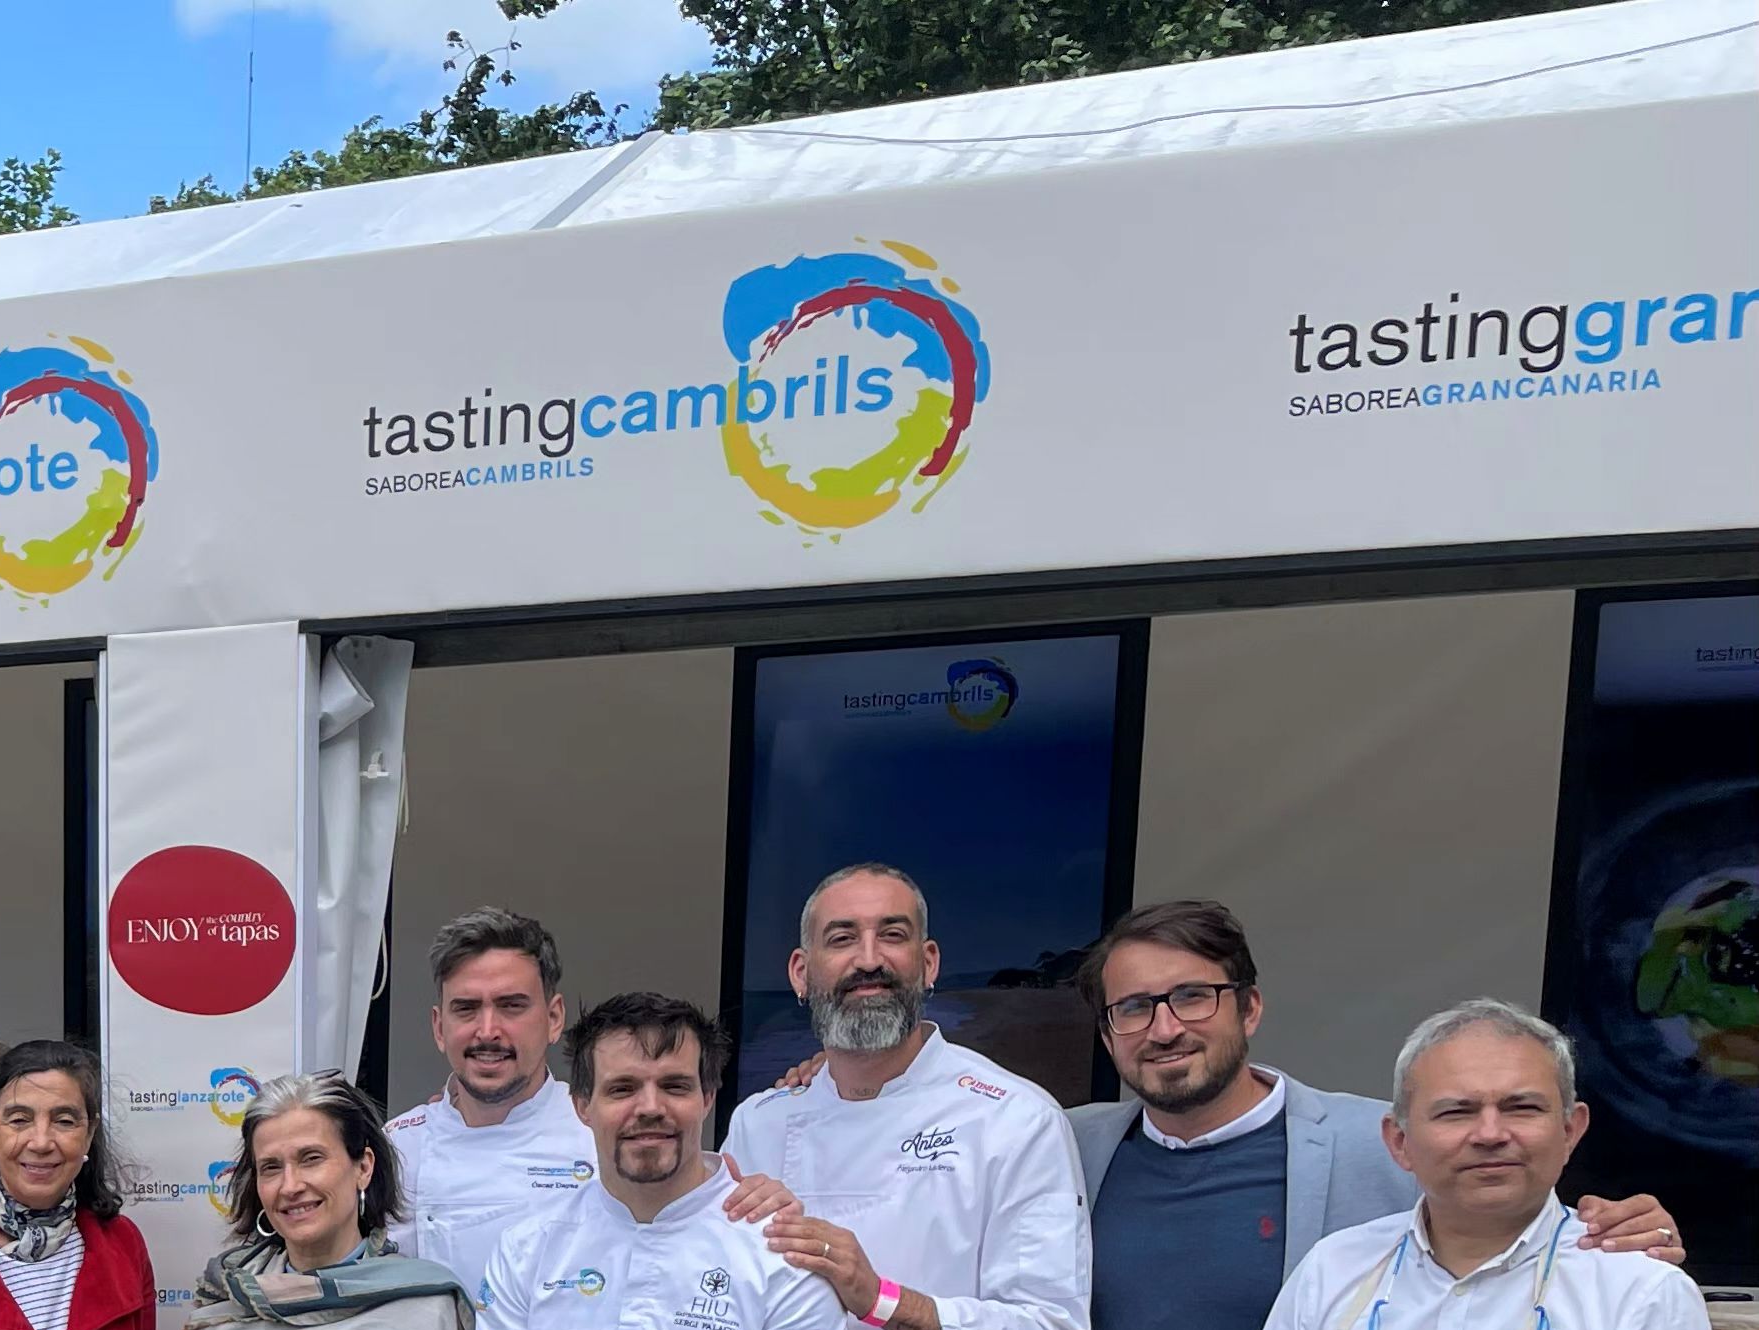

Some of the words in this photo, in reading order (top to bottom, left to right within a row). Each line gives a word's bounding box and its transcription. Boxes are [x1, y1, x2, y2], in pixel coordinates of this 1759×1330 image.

[362, 355, 894, 457] tastingcambrils
[1288, 368, 1662, 417] SABOREAGRANCANARIA
[364, 457, 595, 496] SABOREACAMBRILS
[128, 917, 205, 943] ENJOY
[219, 911, 265, 925] country
[207, 926, 218, 936] of
[221, 923, 280, 947] tapas
[129, 1089, 245, 1106] tastinglanzarote
[691, 1296, 729, 1317] HIU
